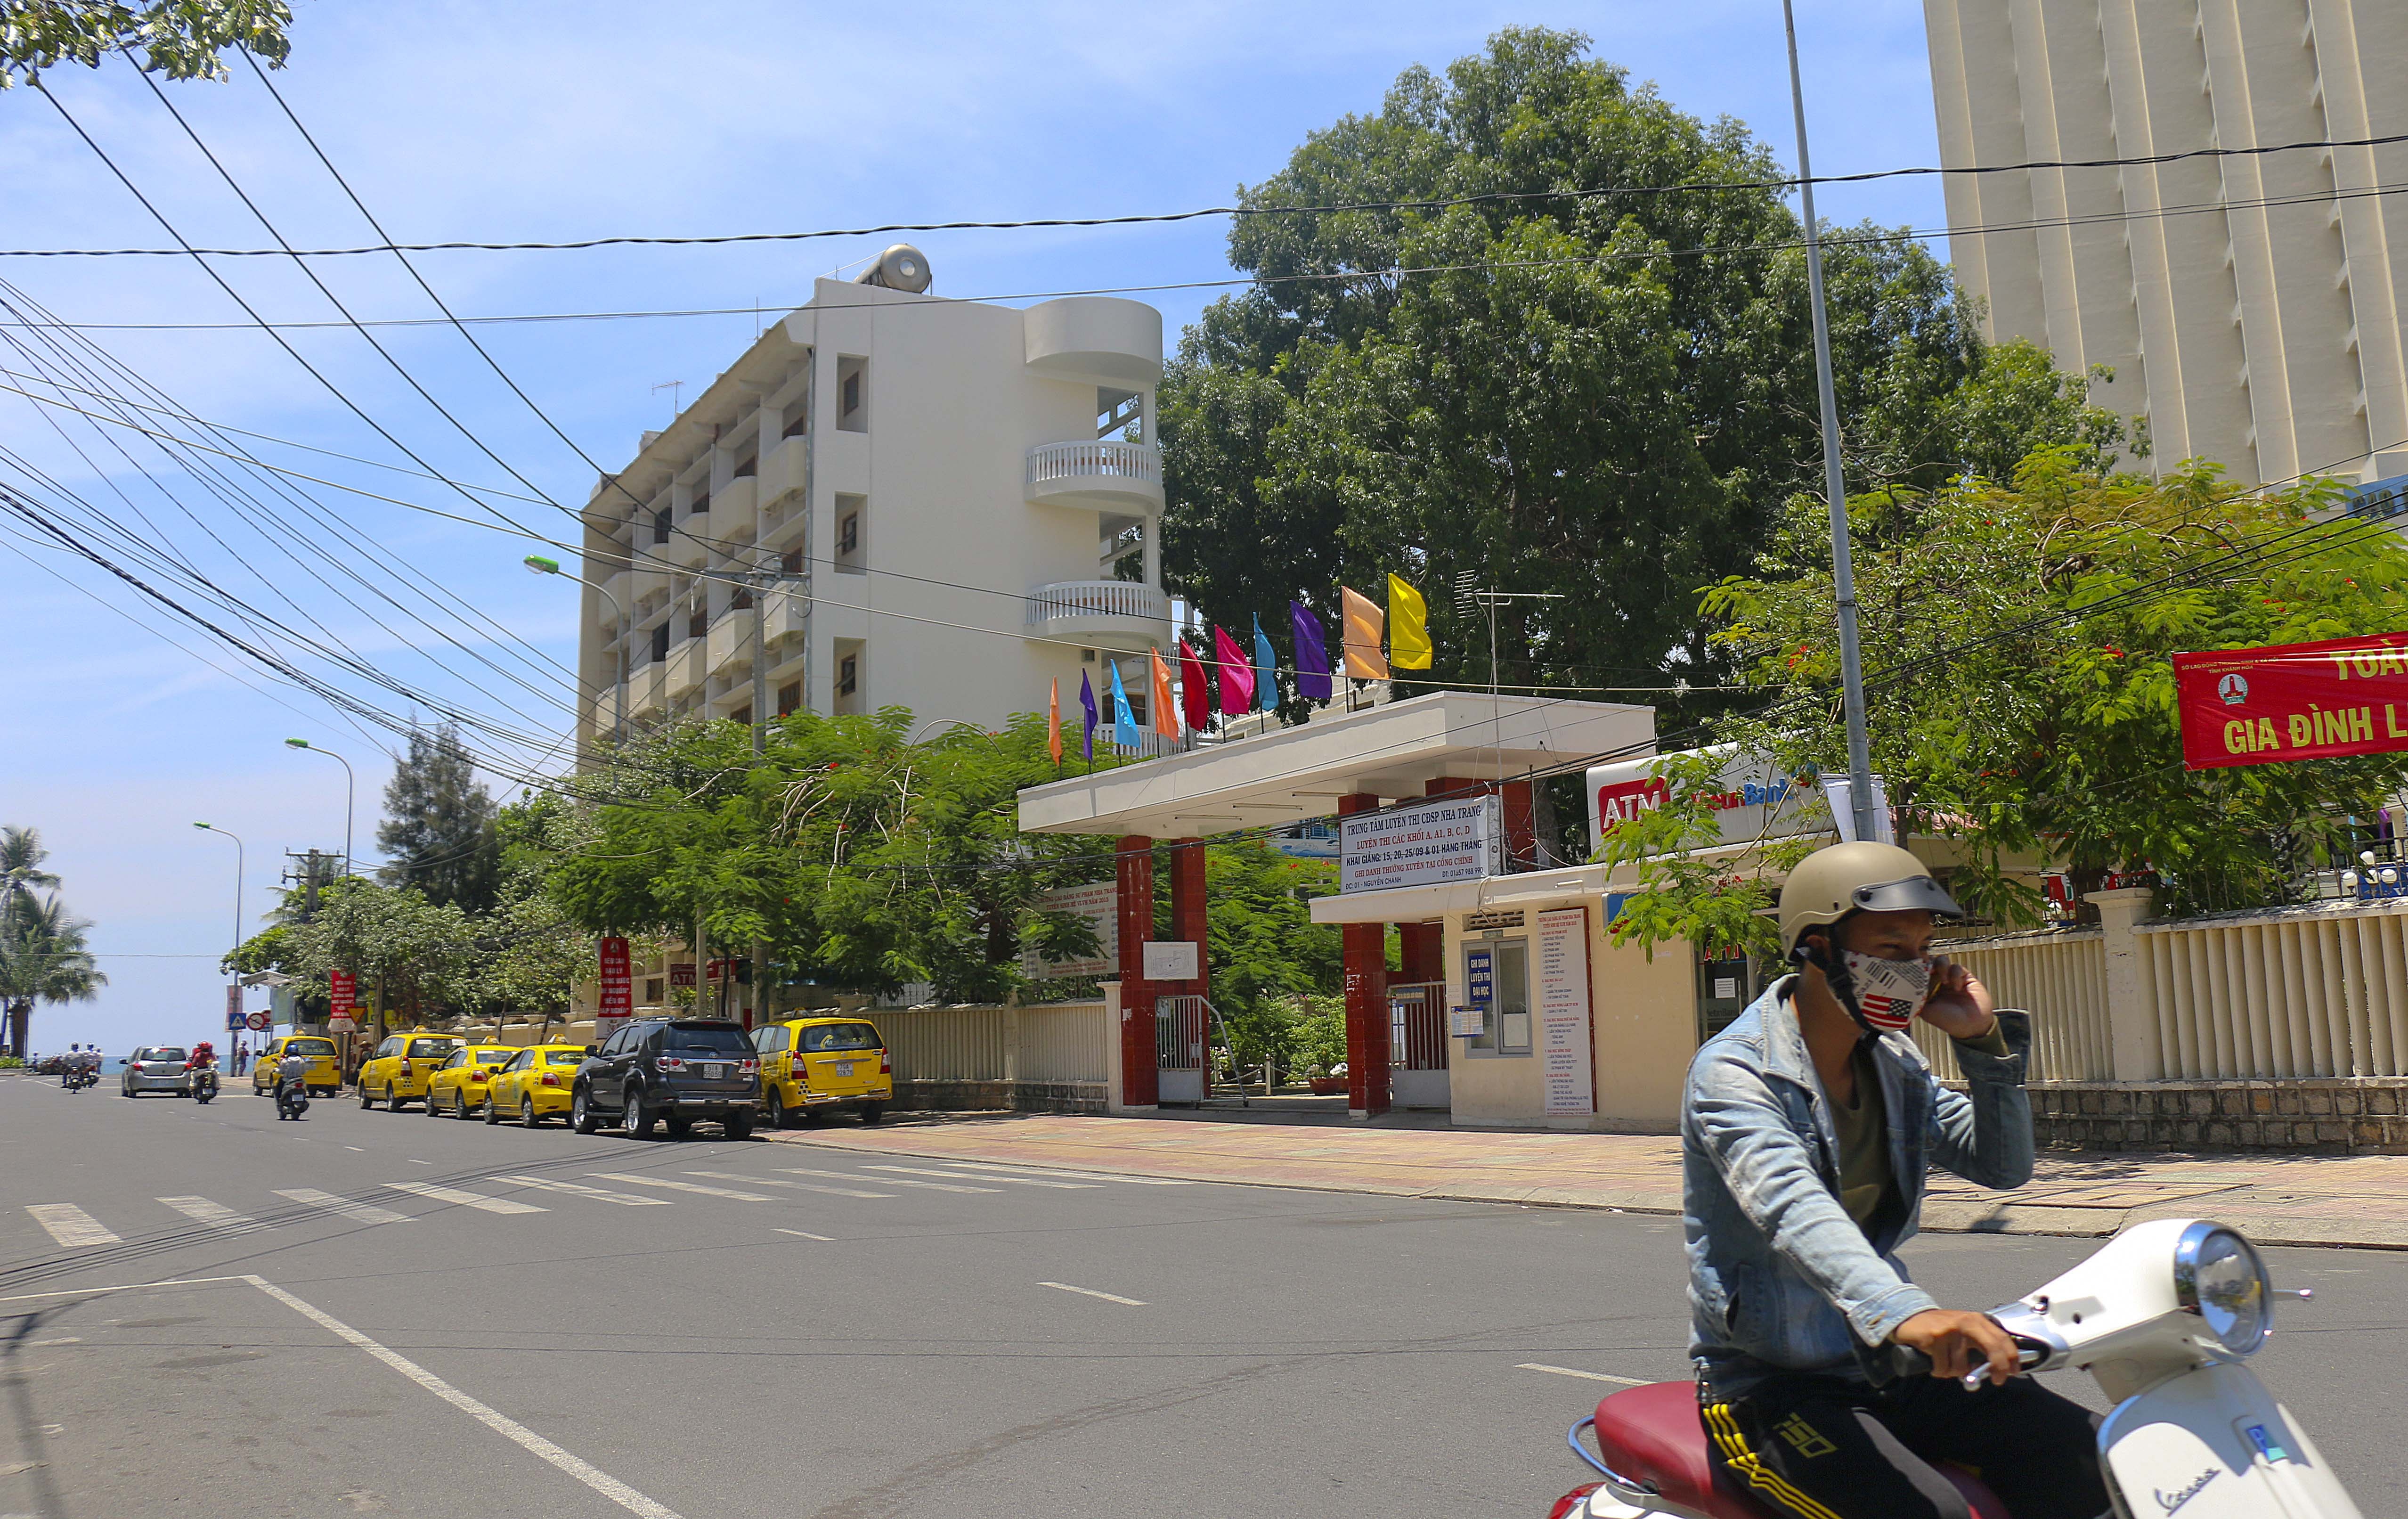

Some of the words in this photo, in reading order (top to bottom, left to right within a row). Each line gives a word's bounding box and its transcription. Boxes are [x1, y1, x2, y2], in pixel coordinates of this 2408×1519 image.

[2329, 639, 2408, 680] TOÀ
[2224, 718, 2280, 754] GIA
[2288, 703, 2374, 748] ĐÌNH
[1347, 823, 1368, 836] TRUNG
[1369, 818, 1383, 832] TÂM
[1385, 814, 1406, 830] LUYỆN
[1407, 814, 1420, 825] THI
[1422, 811, 1439, 824] CĐSP
[1441, 809, 1456, 821] NHA
[1457, 805, 1481, 819] TRANG
[1603, 791, 1661, 828] ATM
[1357, 837, 1377, 850] LUYỆN
[1379, 837, 1390, 846] THI
[1392, 833, 1405, 844] CÁC
[1407, 828, 1424, 842] KHỐI
[1425, 831, 1432, 840] A,
[1434, 829, 1445, 838] A1,
[1447, 828, 1454, 837] B,
[1456, 827, 1463, 836] C,
[1465, 825, 1470, 834] D
[1346, 856, 1360, 866] KHAI
[1362, 851, 1381, 864] GIẢNG:
[1383, 852, 1392, 862] 15,
[1394, 850, 1403, 860] 20,
[1405, 847, 1424, 858] 25/09
[1425, 846, 1430, 855] &
[1432, 845, 1440, 854] 01
[1441, 841, 1459, 853] HÀNG
[1460, 838, 1482, 851] THÁNG
[1355, 870, 1365, 878] GHI
[1366, 867, 1381, 876] DANH
[1382, 863, 1404, 874] THƯỜNG
[1406, 860, 1424, 871] XUYÊN
[1426, 860, 1435, 870] TẠI
[1437, 855, 1452, 867] CỔNG
[1454, 855, 1473, 865] CHÍNH
[1364, 876, 1383, 887] NGUYỄN
[1384, 876, 1401, 884] CHÁNH
[1470, 971, 1483, 983] LUYỆN
